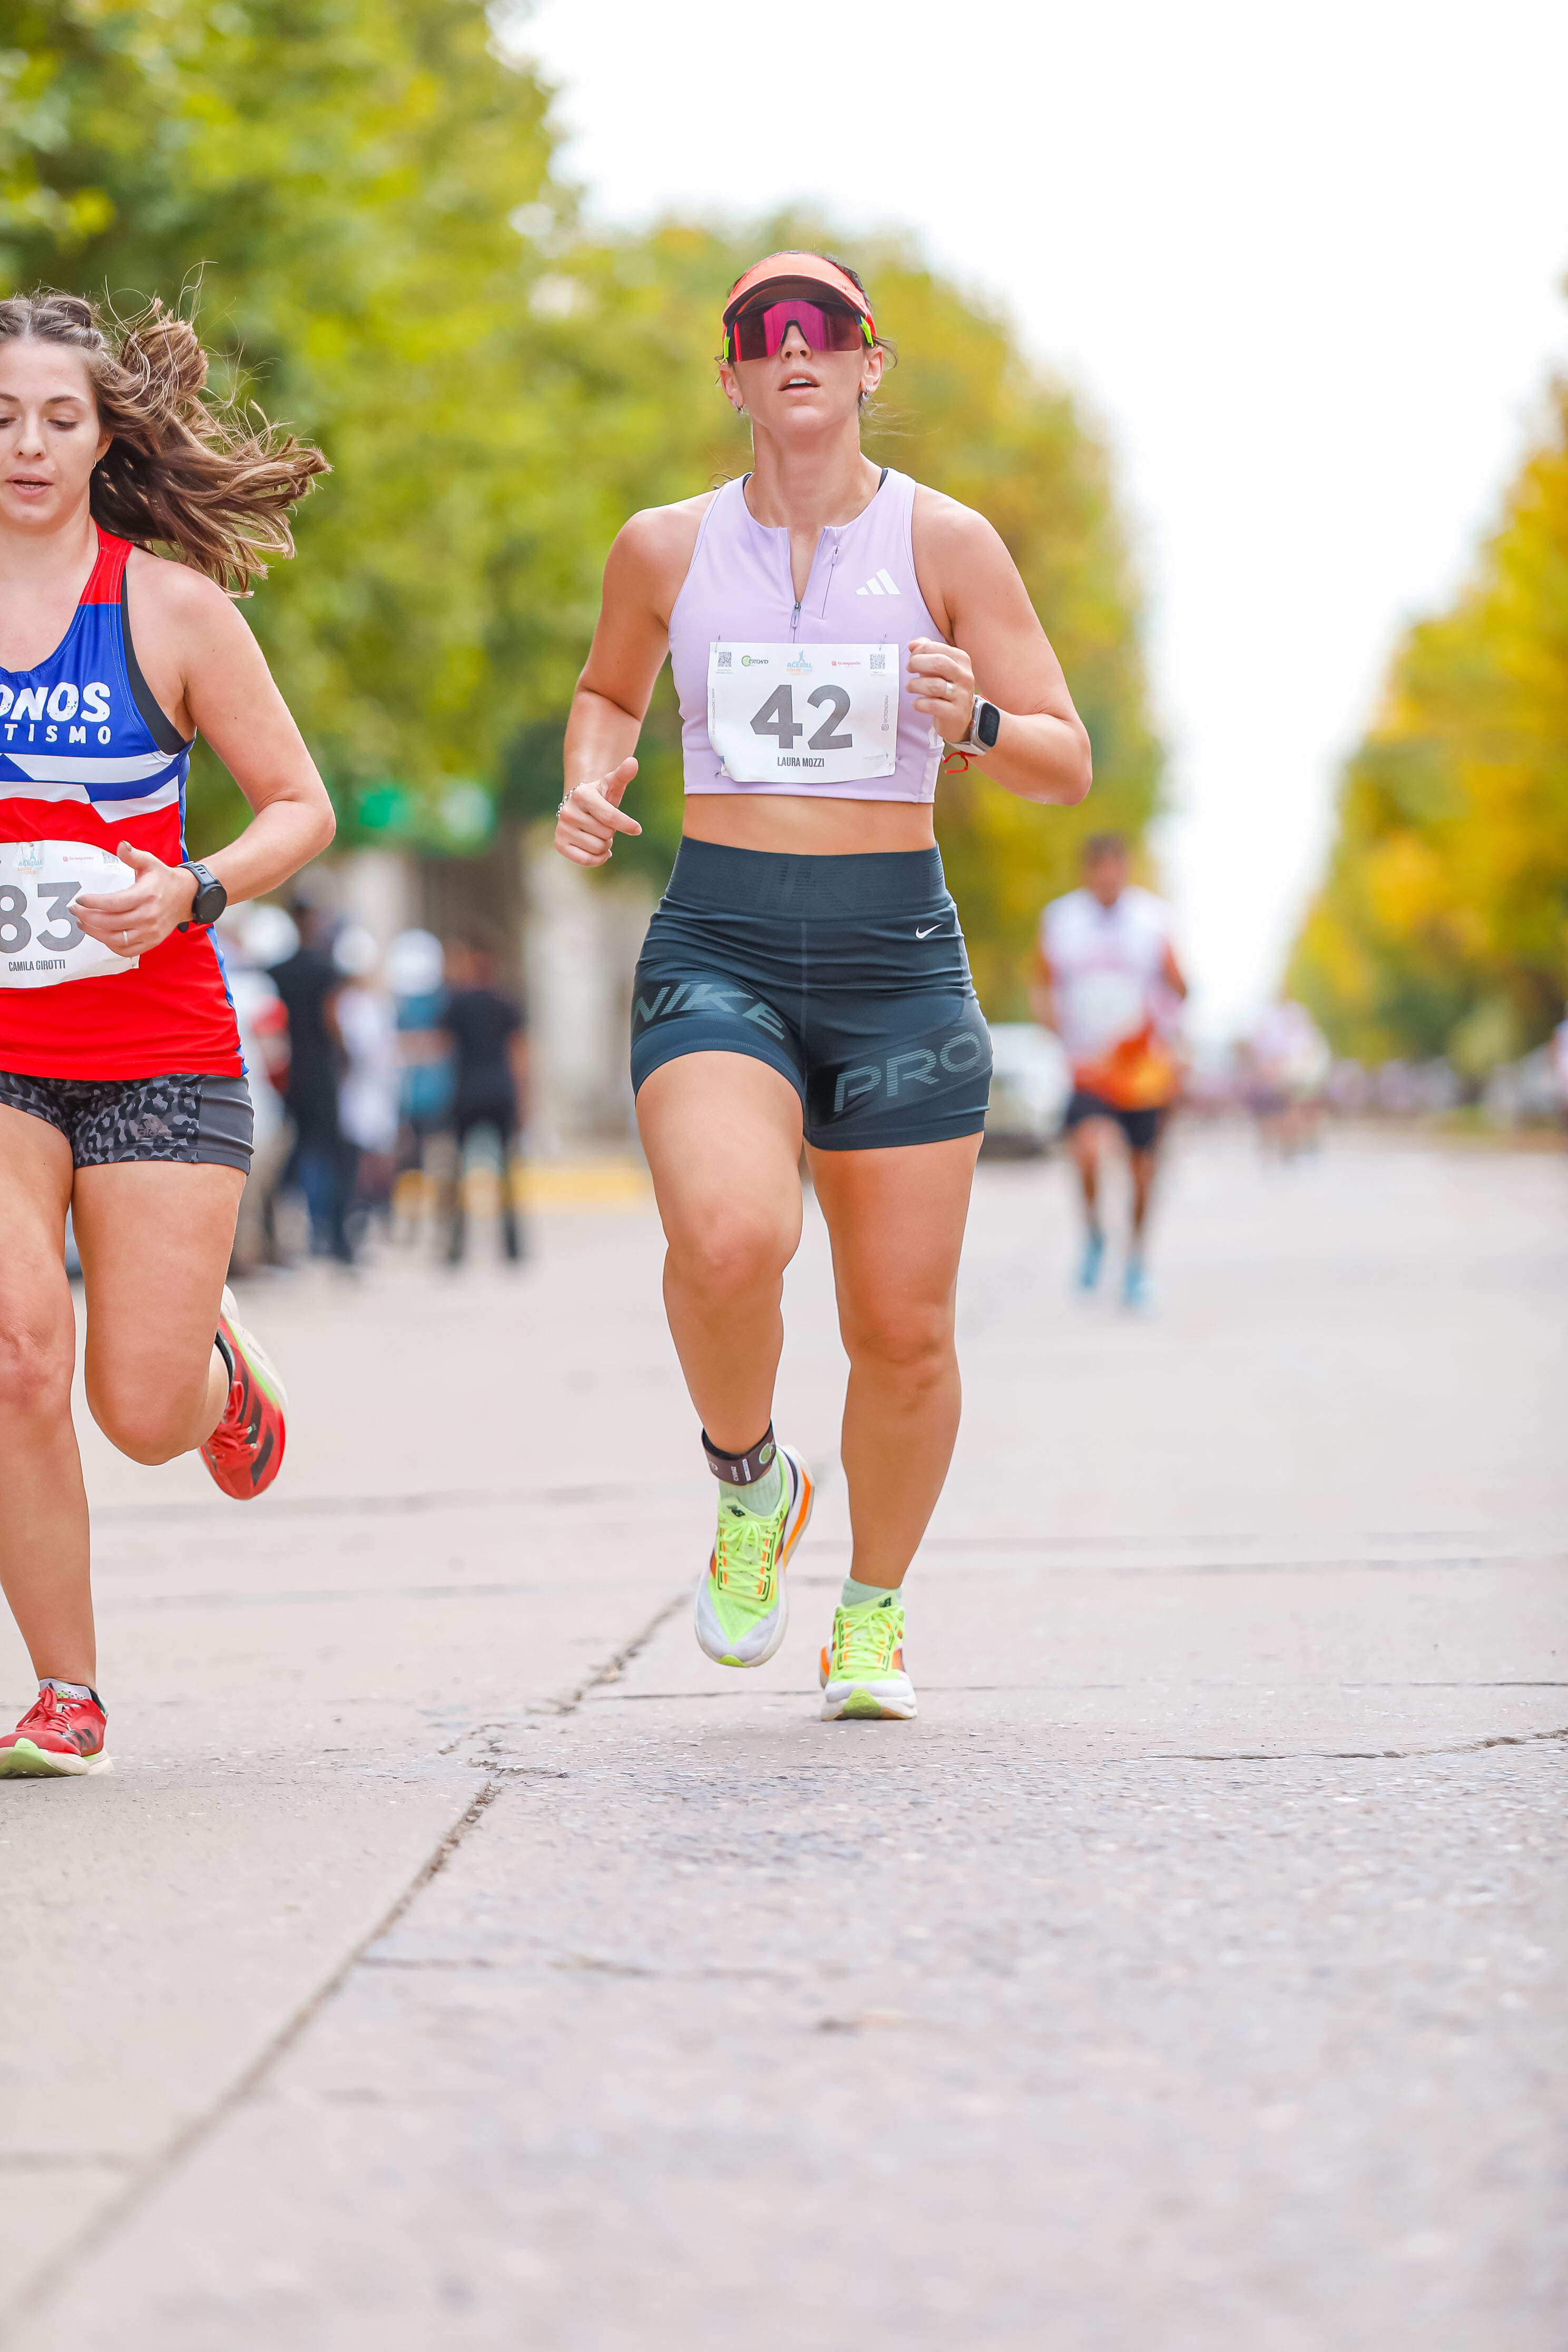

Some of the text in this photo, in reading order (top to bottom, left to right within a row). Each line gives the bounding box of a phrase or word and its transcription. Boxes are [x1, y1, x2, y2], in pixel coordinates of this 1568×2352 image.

[750, 685, 852, 750] 42
[777, 757, 825, 768] LAURA MOZZI
[0, 881, 86, 954] 83
[8, 959, 66, 972] CAMILA GIROTTI
[632, 983, 785, 1041] NIKE
[833, 1031, 982, 1113] PRO
